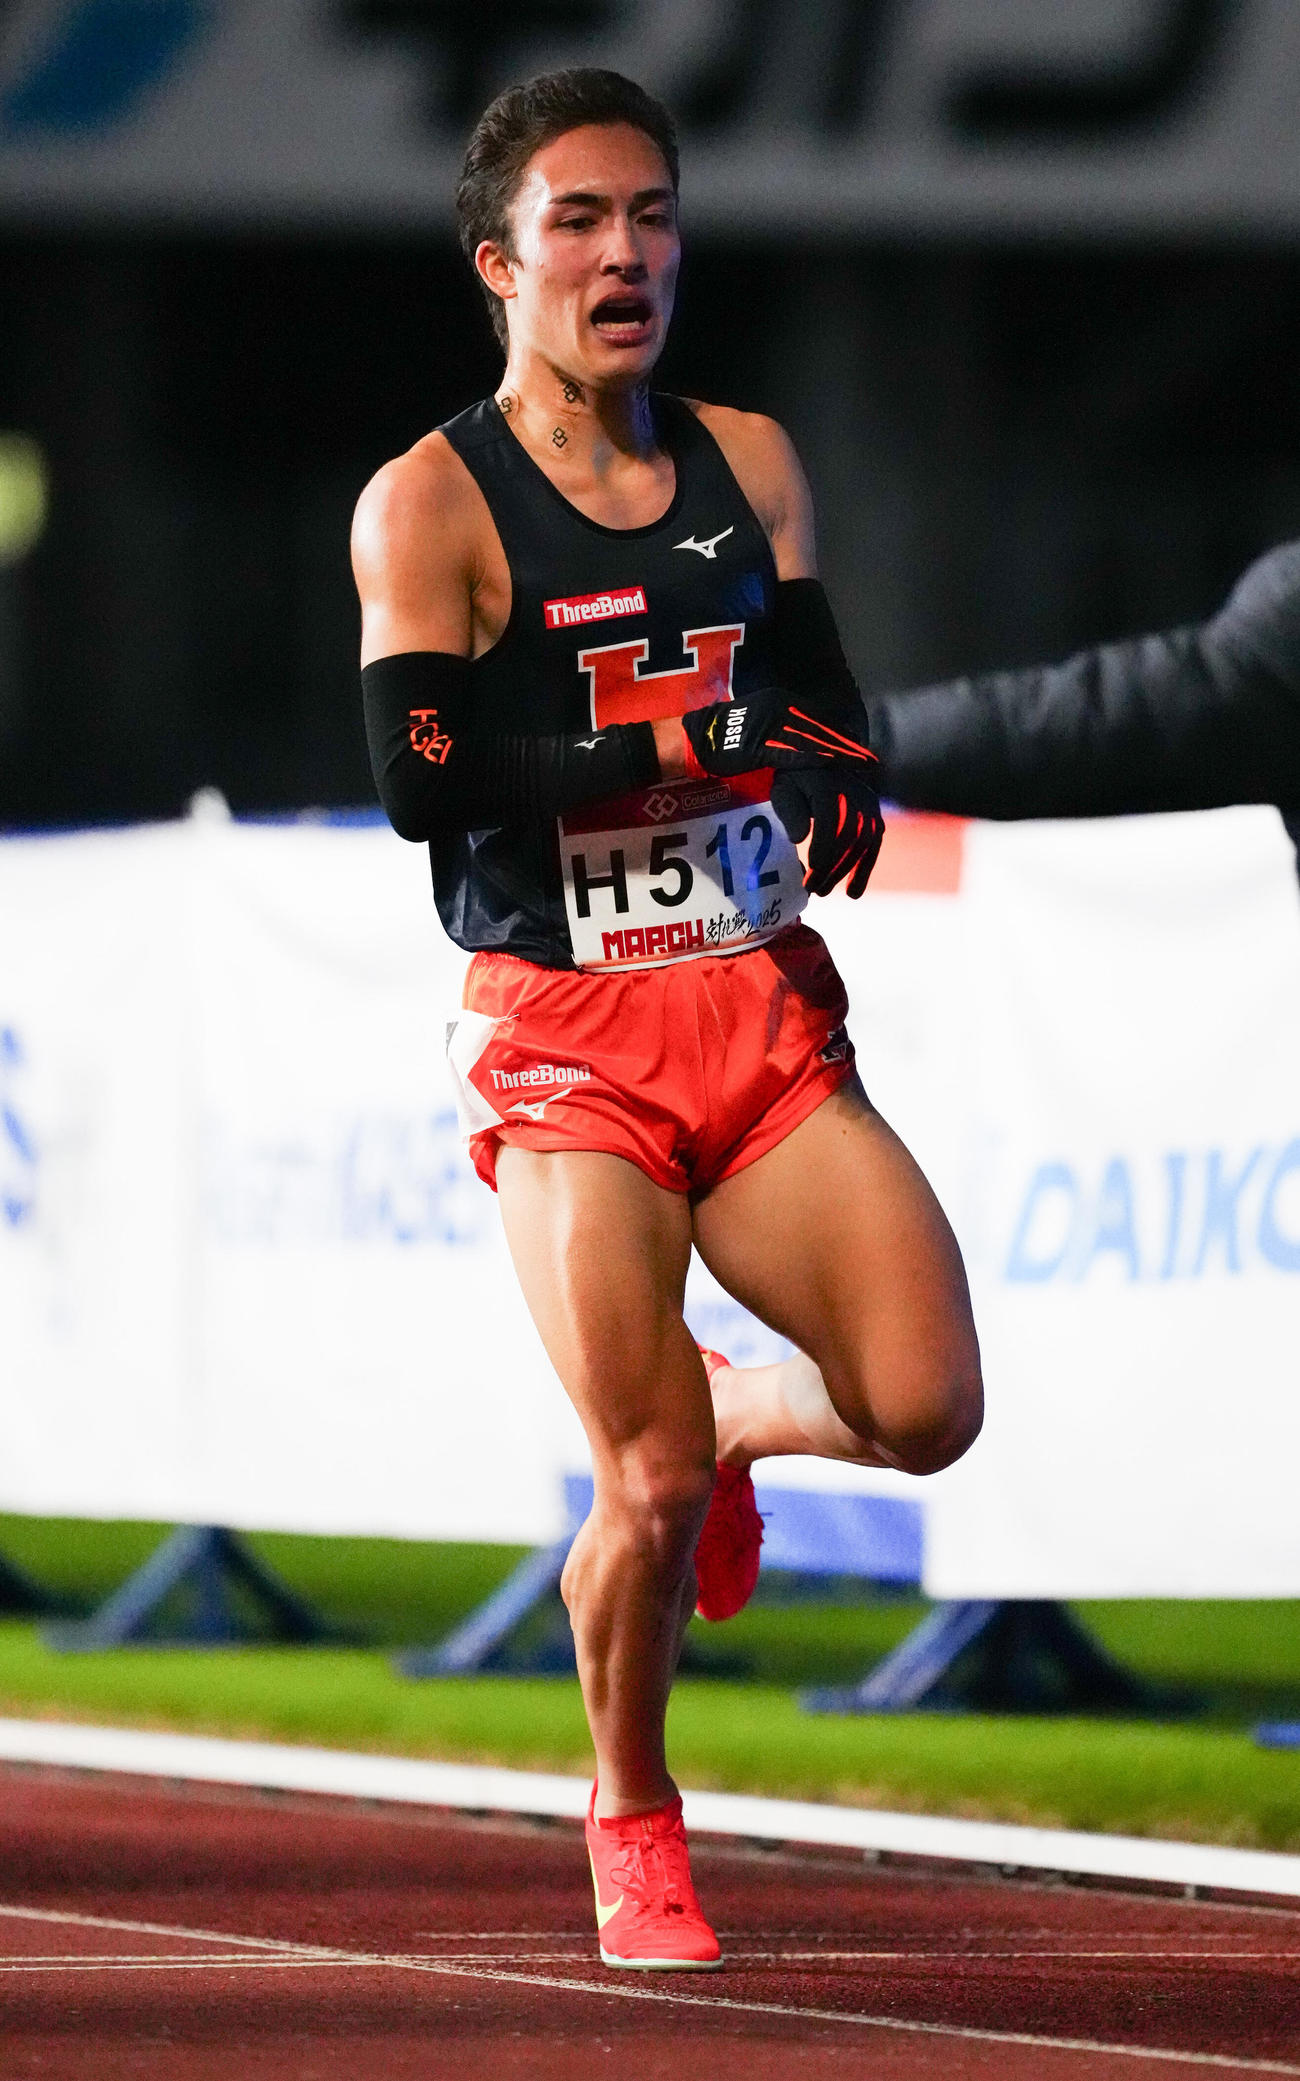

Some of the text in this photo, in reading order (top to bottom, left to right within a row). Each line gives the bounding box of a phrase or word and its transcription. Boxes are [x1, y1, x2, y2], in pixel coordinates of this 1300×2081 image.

[547, 590, 645, 625] ThreeBond
[577, 622, 745, 732] H
[723, 706, 748, 750] HOSEI
[601, 919, 704, 960] MARCH
[490, 1064, 591, 1090] ThreeBond
